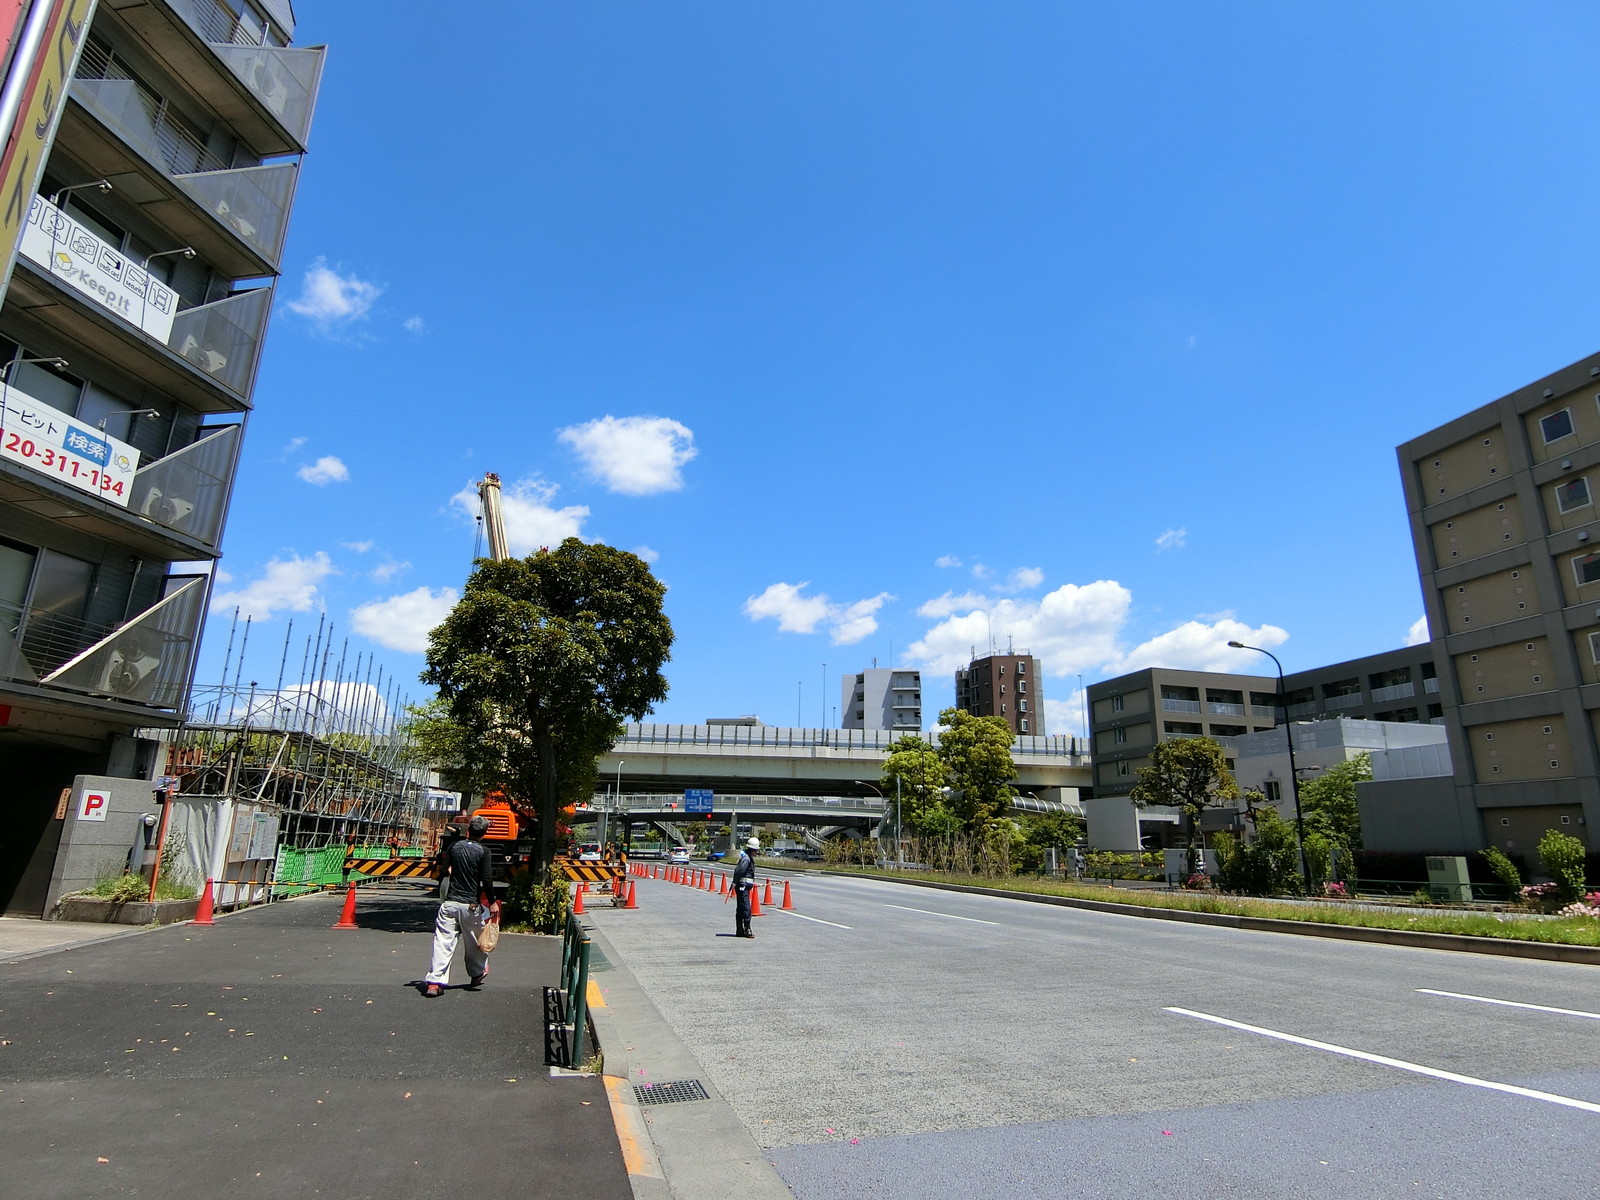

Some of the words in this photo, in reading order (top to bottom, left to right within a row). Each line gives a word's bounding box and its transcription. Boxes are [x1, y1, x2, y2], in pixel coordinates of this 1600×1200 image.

[125, 280, 144, 297] security
[0, 400, 58, 435] ーピット
[67, 431, 108, 461] 検索
[84, 794, 104, 816] P
